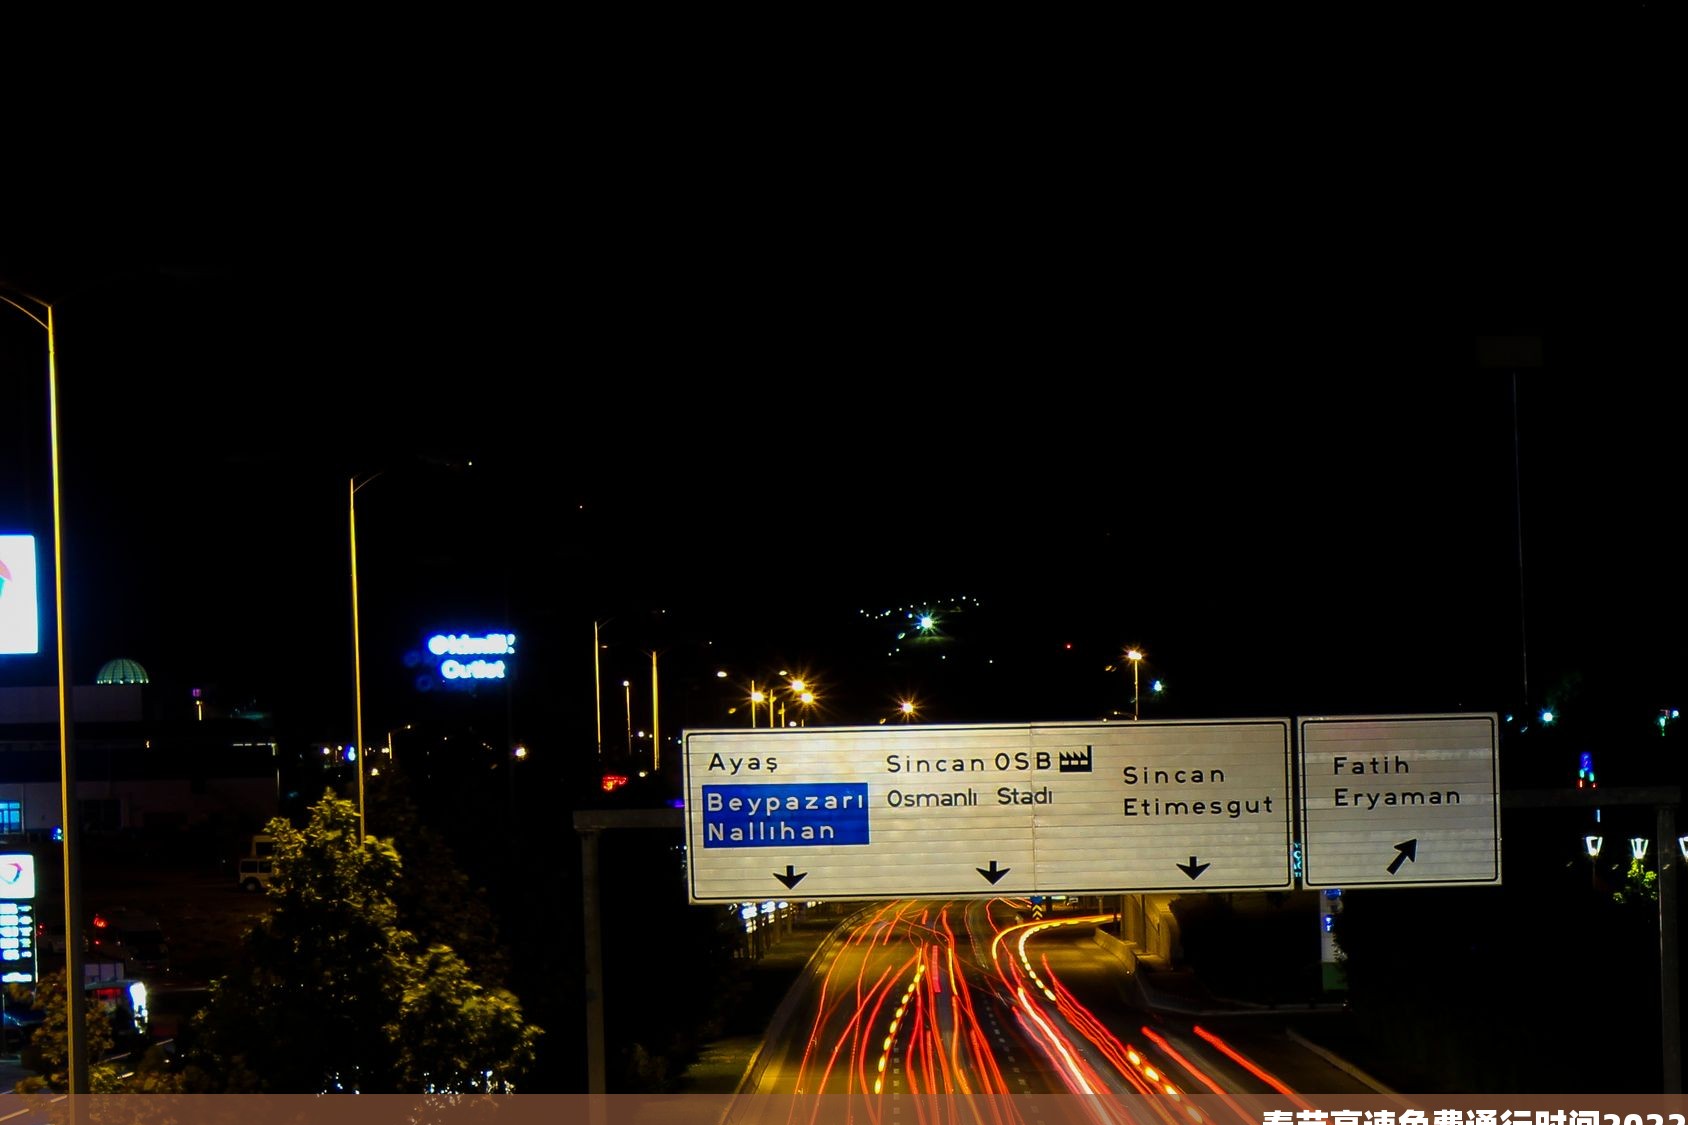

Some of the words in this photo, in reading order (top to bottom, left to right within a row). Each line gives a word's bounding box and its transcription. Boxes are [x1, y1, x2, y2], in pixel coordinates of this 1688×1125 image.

[708, 752, 779, 775] Ayaş
[886, 754, 986, 773] Sincan
[994, 752, 1052, 772] OSB
[1333, 756, 1410, 775] Fatih
[1123, 766, 1226, 785] Sincan
[707, 792, 864, 816] Beypazarı
[887, 788, 979, 808] Osmanlı
[997, 786, 1053, 805] Stadı
[1123, 796, 1274, 818] Etimesgut
[1333, 788, 1461, 811] Eryaman
[707, 821, 836, 842] Nallıhan
